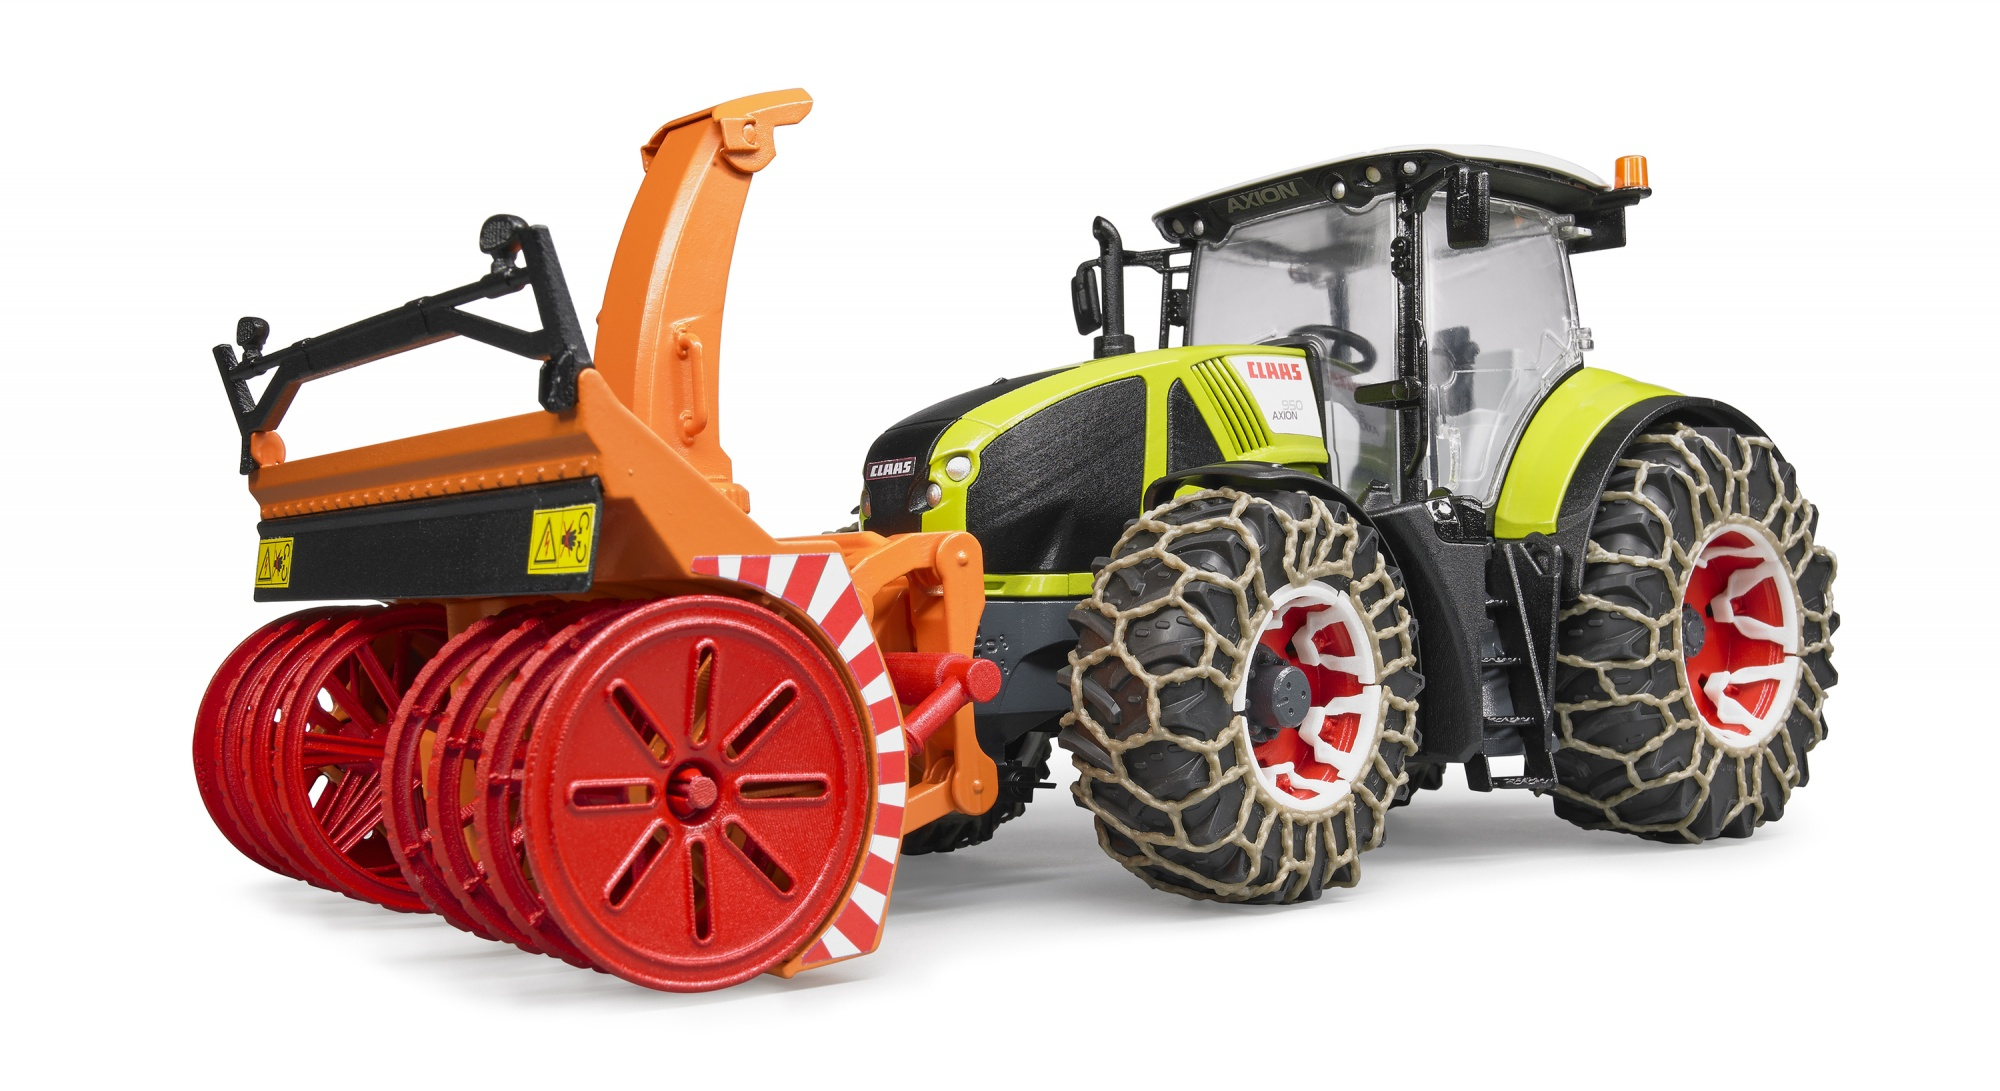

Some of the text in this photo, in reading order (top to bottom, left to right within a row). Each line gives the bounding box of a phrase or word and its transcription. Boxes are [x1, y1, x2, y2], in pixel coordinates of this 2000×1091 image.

[1227, 181, 1299, 214] AXION
[1246, 361, 1303, 381] CLAAS
[1281, 400, 1304, 411] 950
[1272, 410, 1298, 420] AXION
[870, 460, 912, 478] CLAAS
